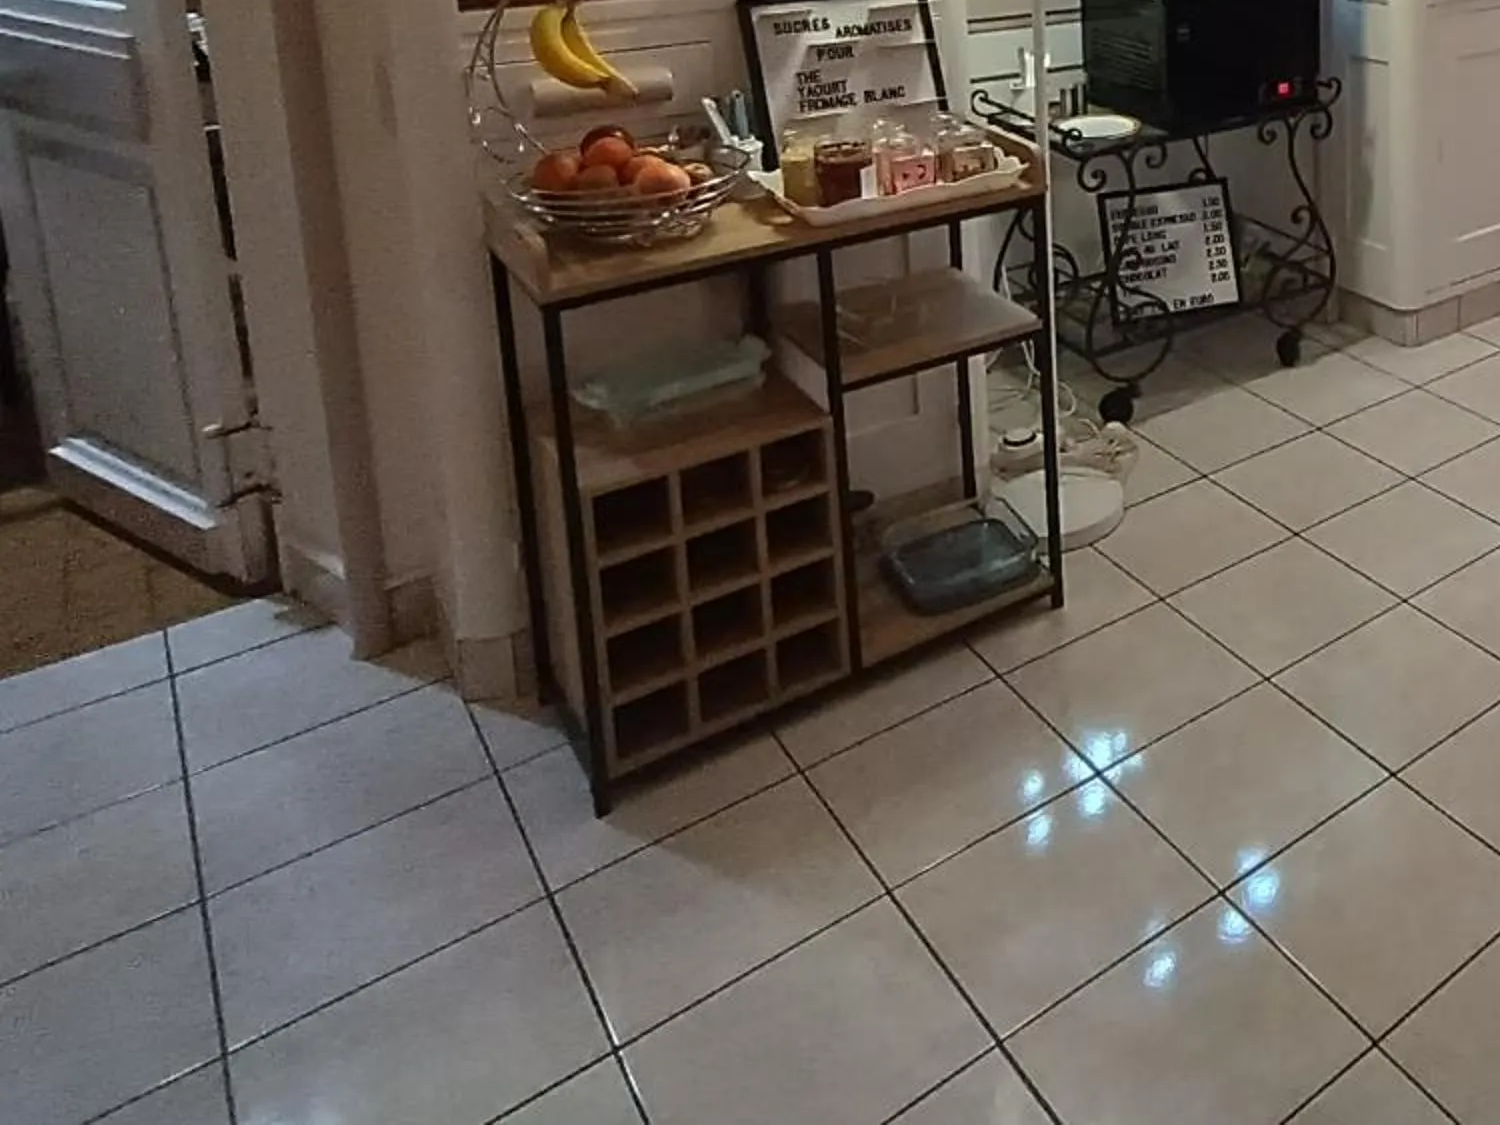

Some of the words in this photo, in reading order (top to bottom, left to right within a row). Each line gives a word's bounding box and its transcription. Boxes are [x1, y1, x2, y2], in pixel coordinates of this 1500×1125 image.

[773, 18, 830, 35] SUCRES
[816, 45, 854, 62] POUR
[796, 69, 822, 85] THE
[797, 79, 848, 98] YAOURT
[799, 92, 858, 113] FROMAGE
[864, 86, 906, 104] BLANC
